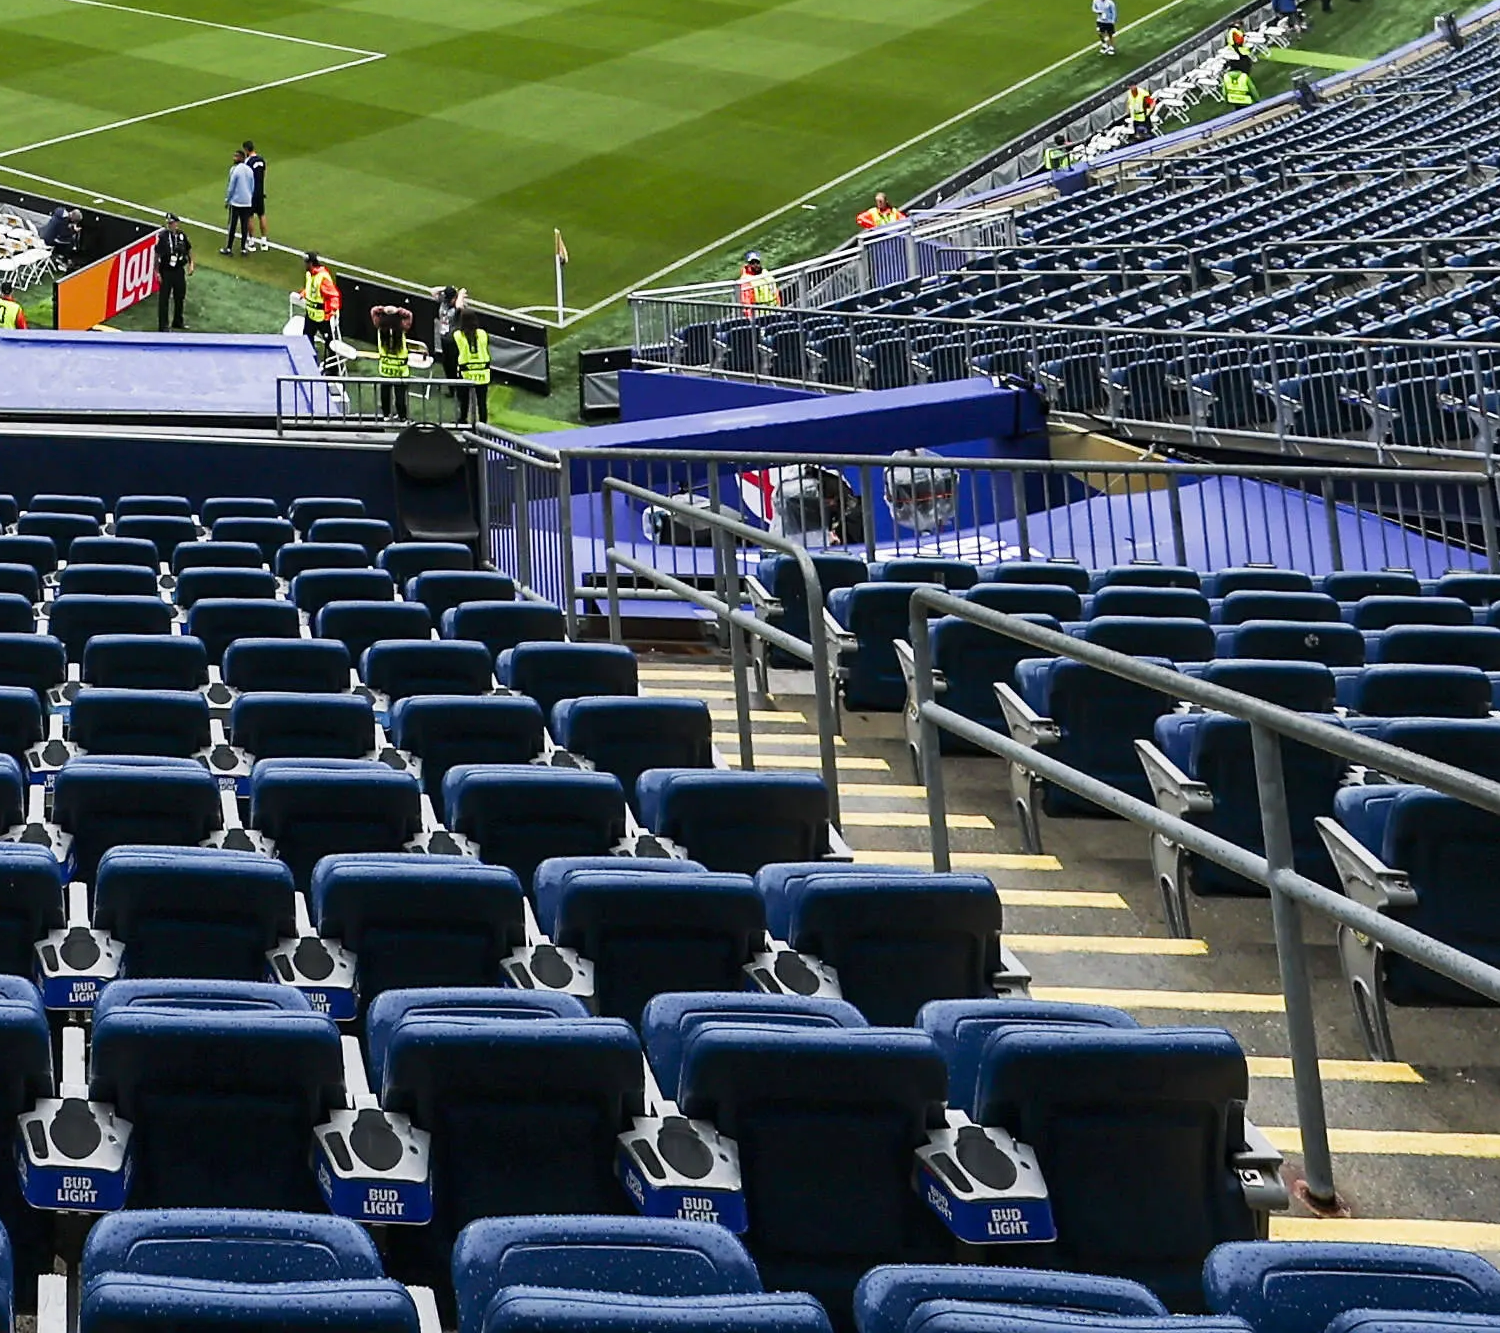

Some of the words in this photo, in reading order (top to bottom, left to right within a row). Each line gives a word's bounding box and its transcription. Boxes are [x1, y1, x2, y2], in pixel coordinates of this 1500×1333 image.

[116, 244, 156, 313] Lay
[73, 981, 96, 992] BUD
[70, 991, 98, 1003] LIGHT
[63, 1176, 91, 1190] BUD
[57, 1189, 98, 1203] LIGHT
[369, 1188, 398, 1201] BUD
[363, 1200, 404, 1215] LIGHT
[683, 1196, 712, 1210] BUD
[676, 1209, 718, 1223] LIGHT
[992, 1208, 1021, 1222] BUD
[987, 1221, 1028, 1236] LIGHT
